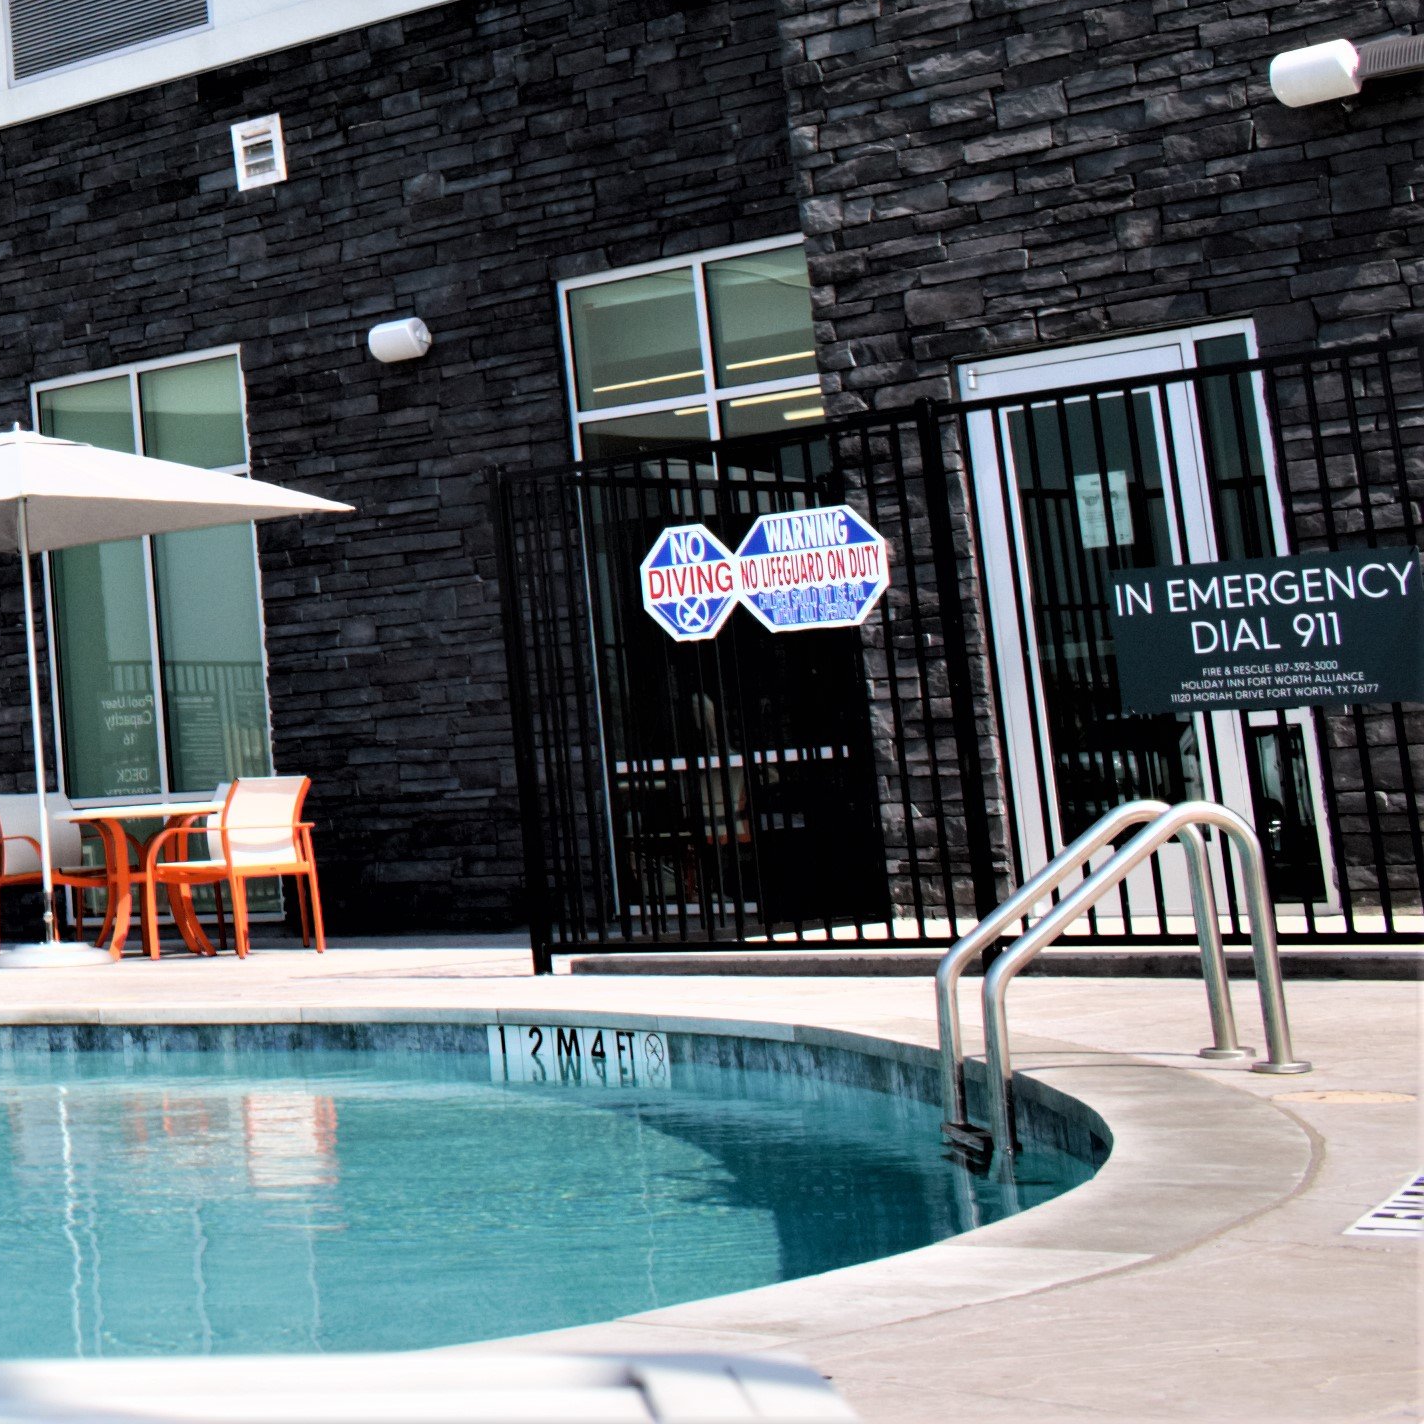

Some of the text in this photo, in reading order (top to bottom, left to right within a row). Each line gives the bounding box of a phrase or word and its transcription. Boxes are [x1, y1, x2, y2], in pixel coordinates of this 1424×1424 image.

[669, 531, 706, 565] NO
[763, 511, 848, 553] WARNING
[648, 562, 734, 600] DIVING
[740, 544, 880, 590] NO LIFEGUARD ON DUTY
[1114, 560, 1413, 617] IN EMERGENCY
[1191, 611, 1342, 654] DIAL 911
[1181, 671, 1365, 690] HOLIDAY INN FORT WORTH ALLIANCE
[1202, 667, 1222, 676] FIRE
[1224, 666, 1231, 676] &
[1274, 660, 1338, 673] 817-392-3000
[1193, 691, 1233, 702] MORIAH
[1235, 689, 1264, 699] DRIVE
[1266, 687, 1291, 698] FORT
[1294, 686, 1334, 697] WORTH,
[1336, 685, 1350, 695] TX
[1352, 683, 1379, 694] 76177
[557, 1026, 581, 1057] M
[591, 1029, 606, 1058] 4
[615, 1030, 635, 1060] FT
